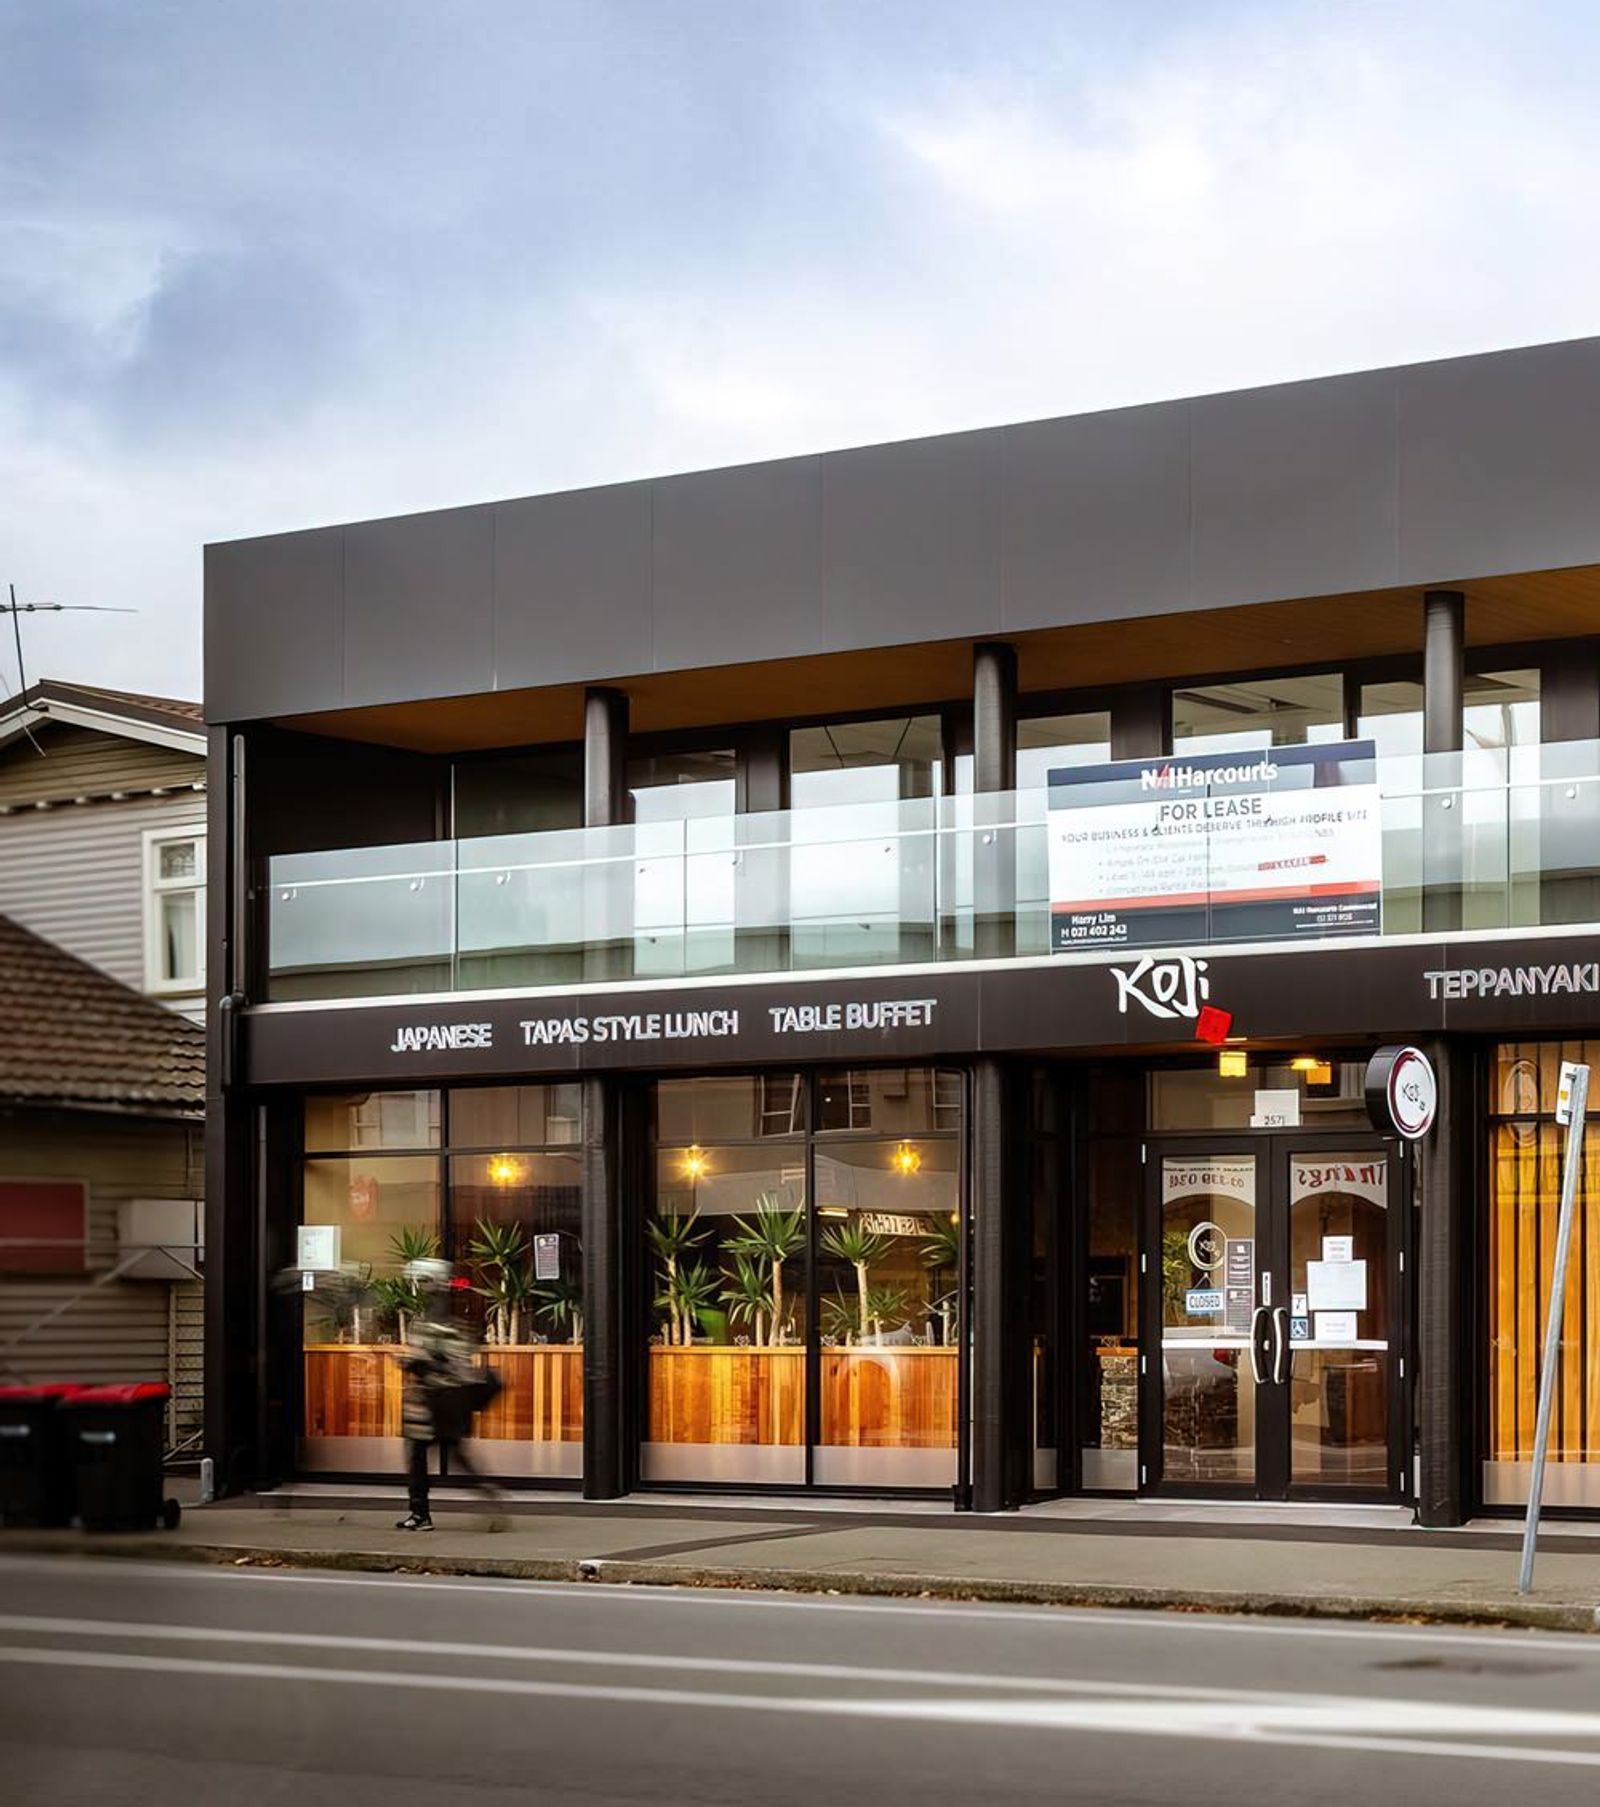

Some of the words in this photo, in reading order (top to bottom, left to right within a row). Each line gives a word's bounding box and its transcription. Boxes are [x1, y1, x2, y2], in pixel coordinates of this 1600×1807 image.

[1177, 761, 1278, 787] Harcourts
[1160, 803, 1197, 821] FOR
[1203, 798, 1262, 818] LEASE
[1424, 963, 1599, 999] TEPPANYAKI
[391, 1022, 492, 1053] JAPANESE
[519, 1017, 589, 1046] TAPAS
[592, 1013, 661, 1042] STYLE
[664, 1009, 739, 1038] LUNCH
[768, 1004, 842, 1033] TABLE
[845, 999, 938, 1031] BUFFET
[1189, 1295, 1220, 1308] CLOSED
